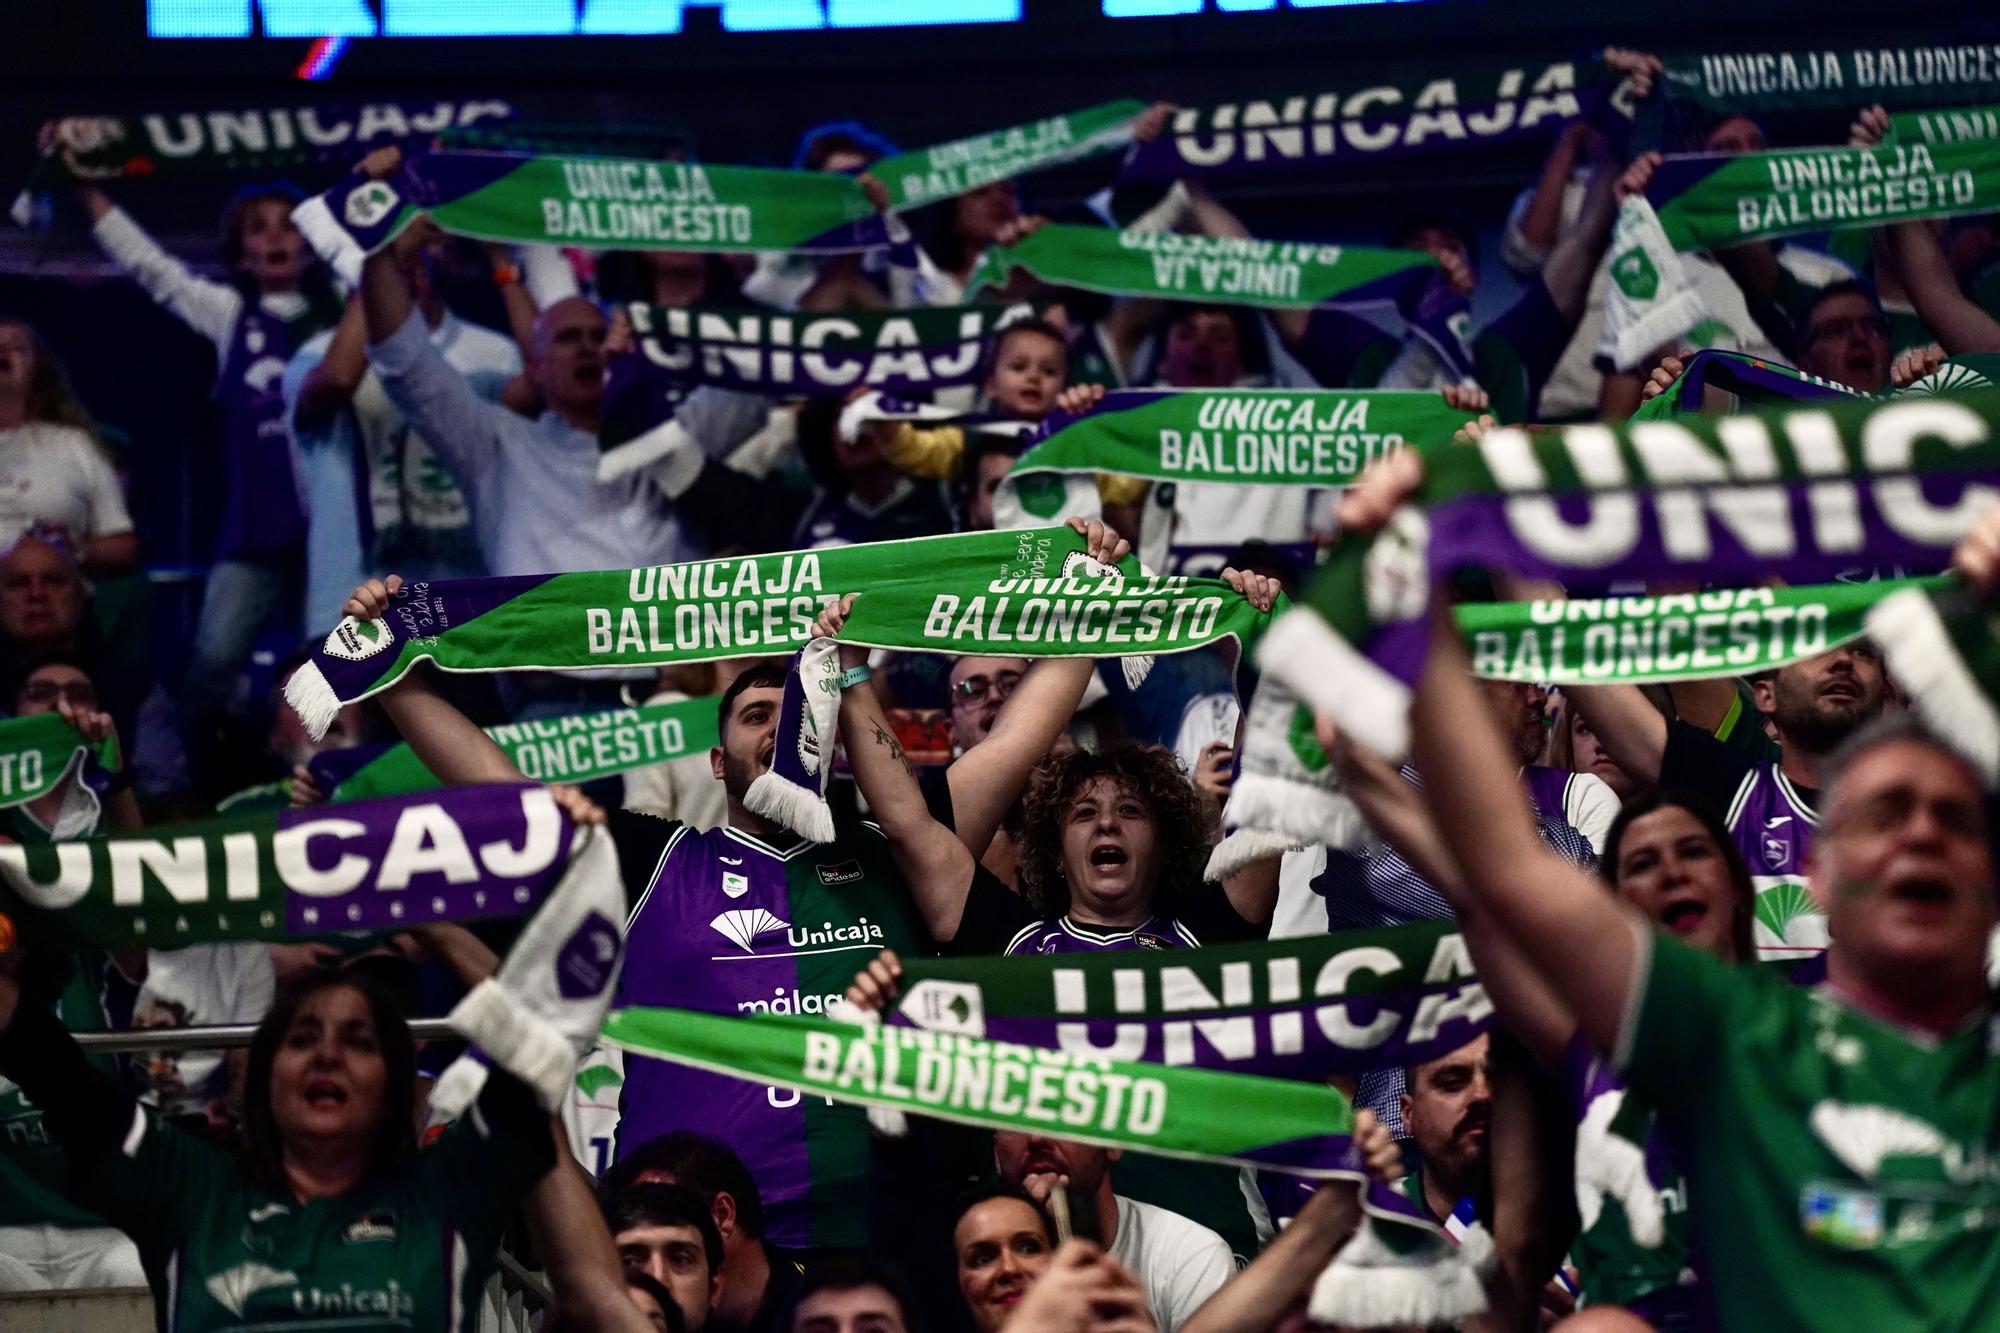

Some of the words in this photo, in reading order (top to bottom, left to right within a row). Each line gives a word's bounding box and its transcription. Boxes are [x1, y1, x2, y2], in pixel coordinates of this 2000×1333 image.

[1702, 51, 1843, 97] UNICAJA
[143, 101, 512, 157] UNICAJA
[1173, 63, 1580, 166] UNICAJA
[563, 161, 716, 202] UNICAJA
[1768, 144, 1935, 192] UNICAJA
[542, 199, 751, 241] BALONCESTO
[1738, 170, 1974, 233] BALONCESTO
[1152, 253, 1300, 297] UNICAJA
[1198, 397, 1369, 431] UNICAJA
[1479, 401, 1998, 567] UNIC
[629, 554, 822, 601] UNICAJA
[344, 623, 362, 651] Unicaja
[586, 594, 841, 654] BALONCES
[923, 594, 1223, 643] BALONCESTO
[1473, 603, 1828, 680] BALONCESTO
[486, 709, 640, 745] NICAJA
[516, 718, 685, 779] ONCESTO
[788, 917, 884, 947] Unicaja
[803, 1032, 1168, 1135] BALONCESTO
[292, 1280, 414, 1319] Unicaja
